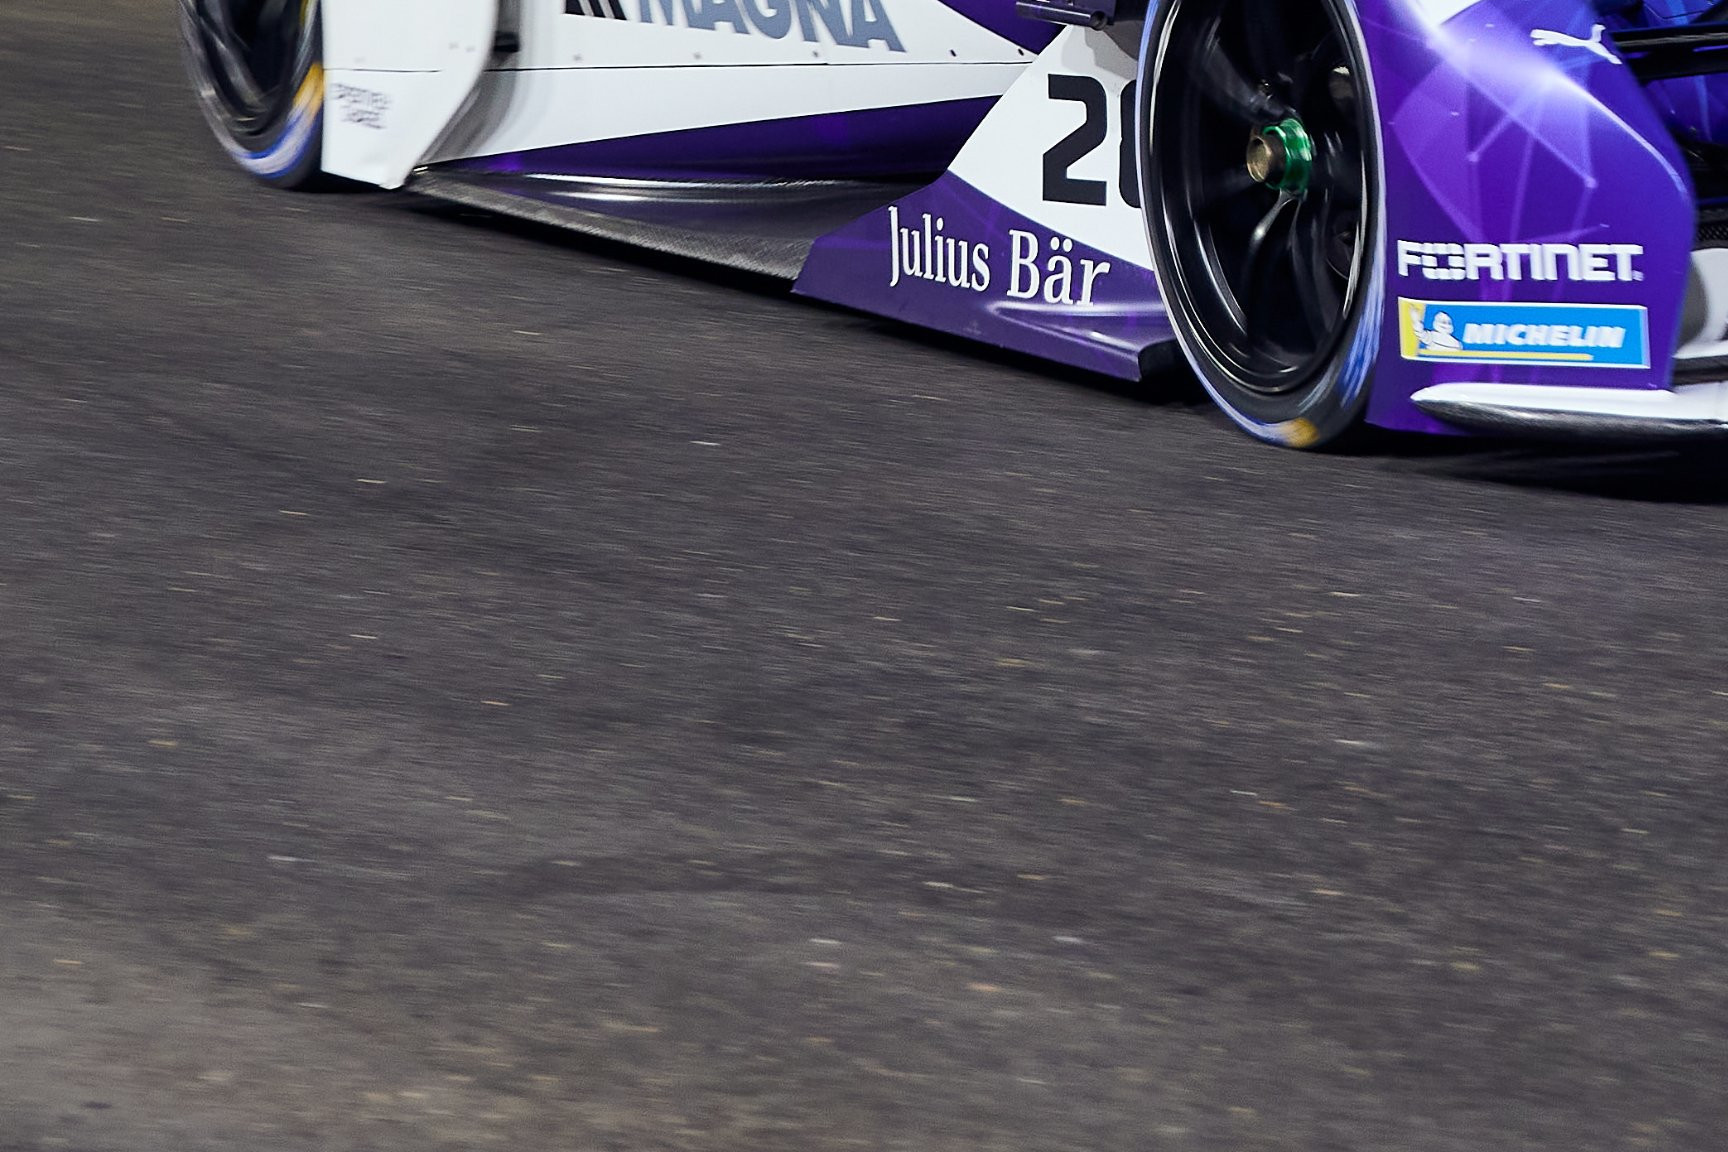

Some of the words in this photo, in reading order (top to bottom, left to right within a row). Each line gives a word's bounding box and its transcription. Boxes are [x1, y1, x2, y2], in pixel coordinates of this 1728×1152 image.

[888, 206, 991, 293] Julius
[1006, 229, 1111, 307] Bär
[1397, 239, 1644, 282] FORTINET
[1463, 323, 1626, 348] MICHELIN
